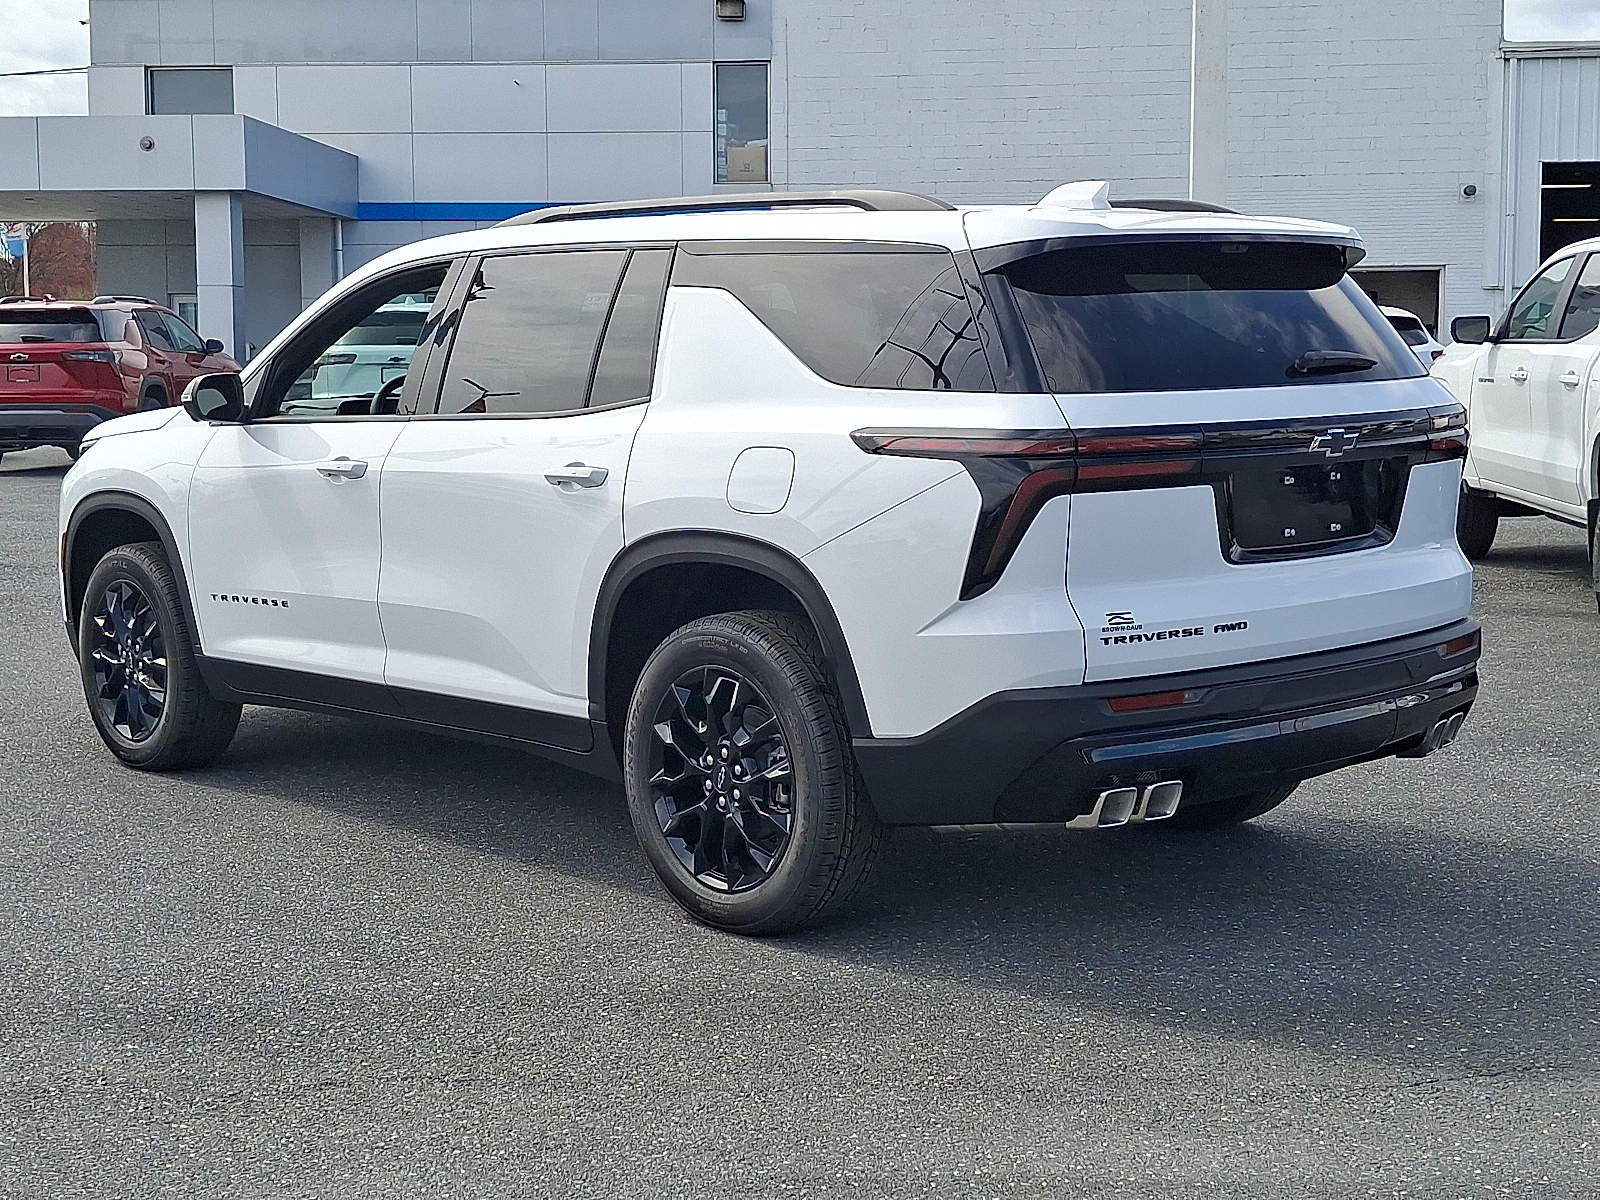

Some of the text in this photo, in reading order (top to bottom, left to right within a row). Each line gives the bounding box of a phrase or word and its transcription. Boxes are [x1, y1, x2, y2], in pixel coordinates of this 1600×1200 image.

[210, 593, 289, 608] TRAVERSE
[1100, 621, 1248, 646] TRAVERSE AWD
